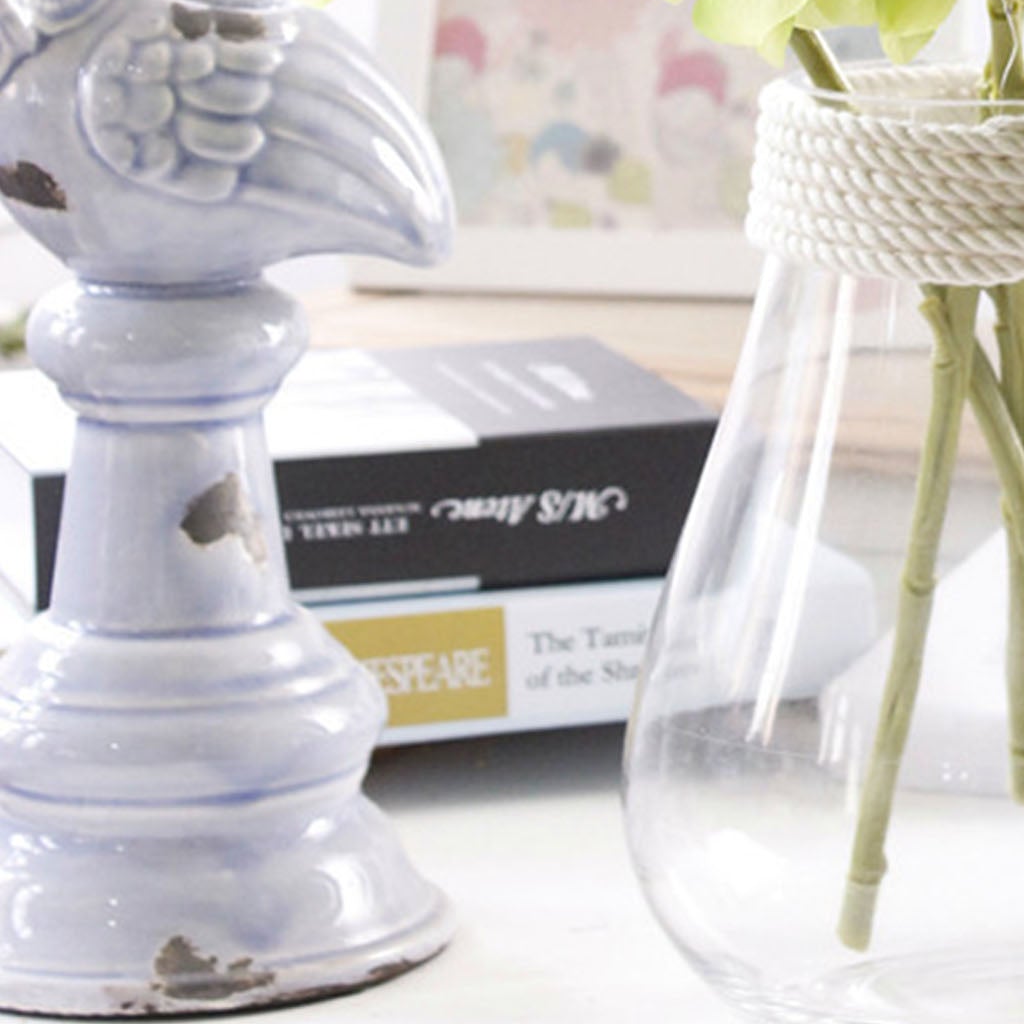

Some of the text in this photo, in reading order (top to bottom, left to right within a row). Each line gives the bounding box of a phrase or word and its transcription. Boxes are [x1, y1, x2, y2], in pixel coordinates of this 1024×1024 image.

[526, 625, 648, 655] The Tami
[357, 647, 492, 695] ESPEARE
[525, 665, 552, 691] of
[557, 664, 594, 687] the
